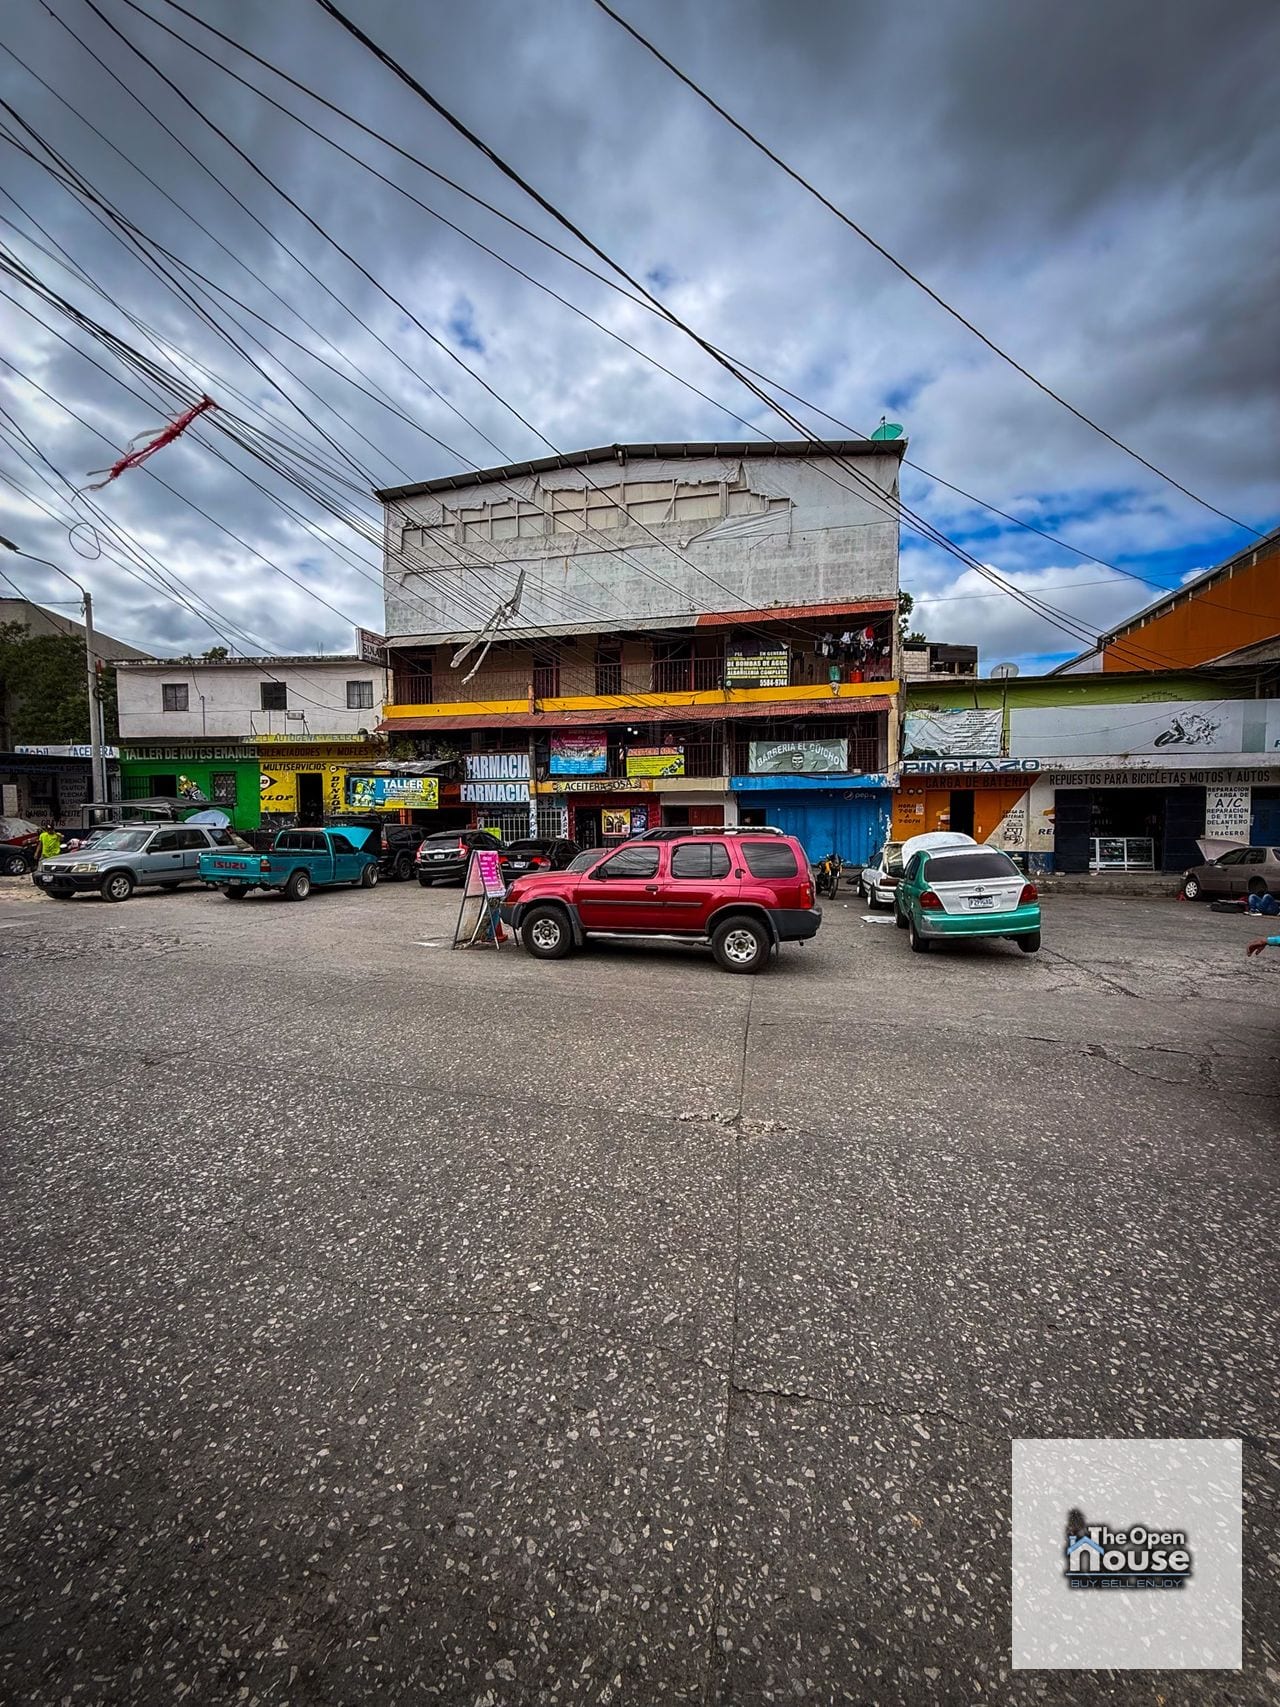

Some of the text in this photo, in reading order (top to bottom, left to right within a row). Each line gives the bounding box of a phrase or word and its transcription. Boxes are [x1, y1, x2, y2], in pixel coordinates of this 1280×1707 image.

[124, 748, 163, 760] TALLER
[165, 748, 178, 759] DE
[213, 747, 260, 759] EMANUEL
[260, 747, 320, 756] SILENCIADORES
[327, 747, 333, 755] Y
[757, 744, 795, 767] BARBERIA
[466, 755, 530, 778] FARMACIA
[903, 760, 1040, 772] PINCHAZO
[926, 776, 961, 788] CARGA
[965, 776, 977, 787] DE
[1049, 770, 1270, 785] REPUESTOS PARA BICICLETAS MOTOS Y AUTOS
[384, 780, 423, 789] TALLER
[461, 784, 530, 801] FARMACIA
[213, 861, 247, 869] ISUZU
